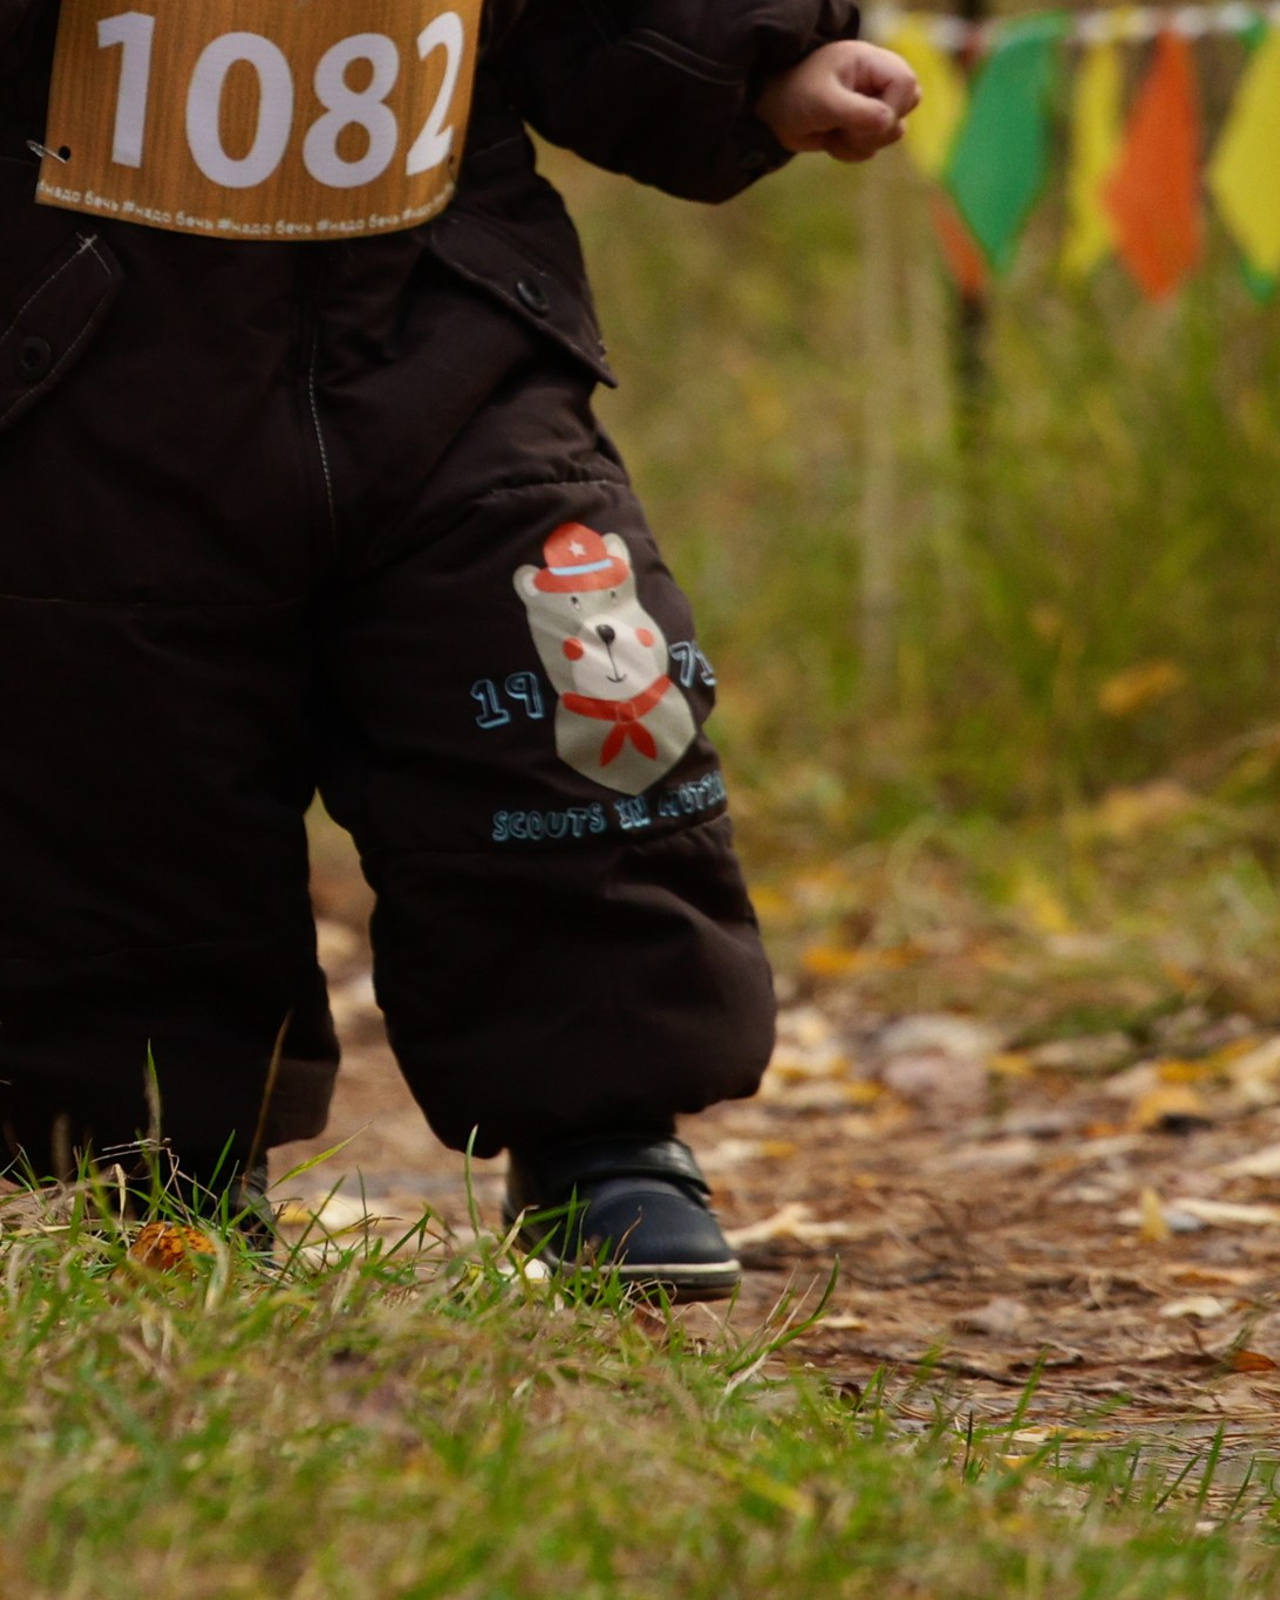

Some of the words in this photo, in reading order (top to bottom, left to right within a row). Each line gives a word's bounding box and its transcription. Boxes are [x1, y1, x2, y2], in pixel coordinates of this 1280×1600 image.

[97, 10, 464, 189] 1082
[470, 670, 544, 729] 19
[492, 802, 608, 842] SCOUTS
